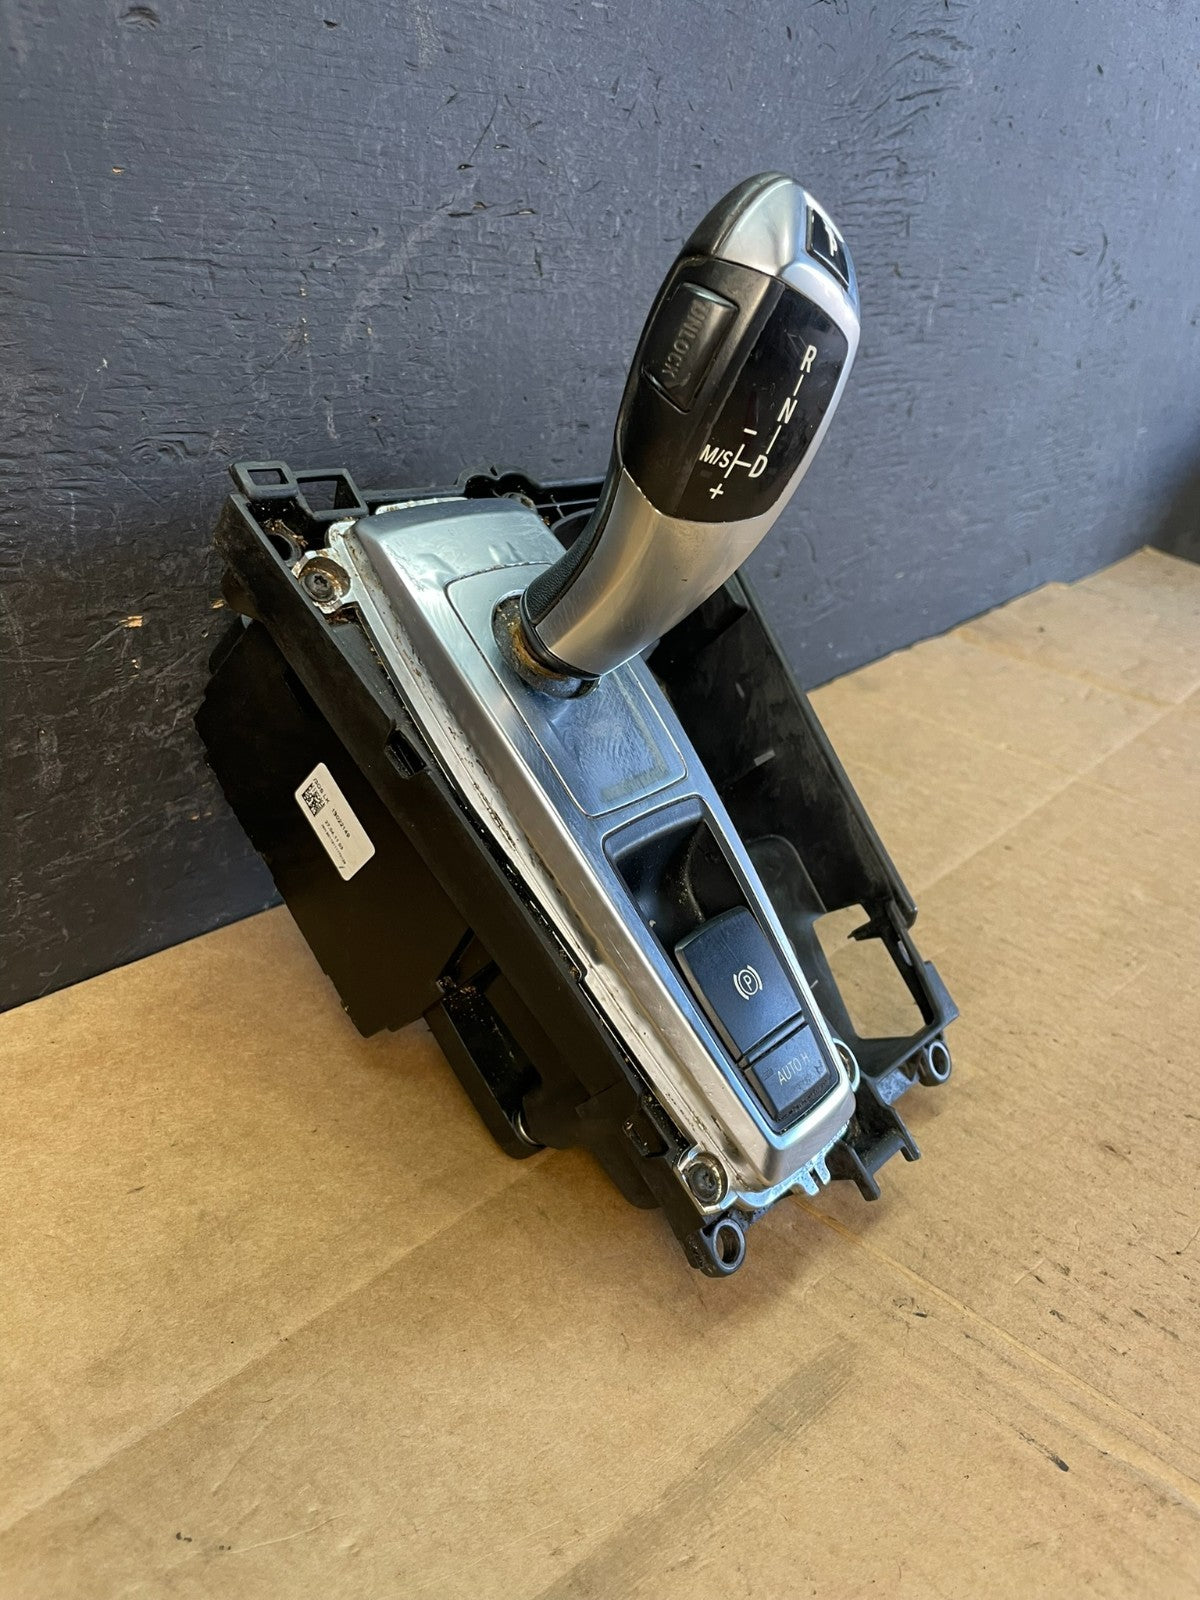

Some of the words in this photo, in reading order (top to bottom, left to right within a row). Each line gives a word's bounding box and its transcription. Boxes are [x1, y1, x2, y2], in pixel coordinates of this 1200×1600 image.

[662, 299, 709, 378] UNLOCK
[800, 345, 817, 373] R
[777, 397, 798, 424] N
[699, 444, 733, 468] M/S
[748, 454, 768, 478] D
[709, 483, 724, 499] +
[777, 1057, 802, 1086] AUTO
